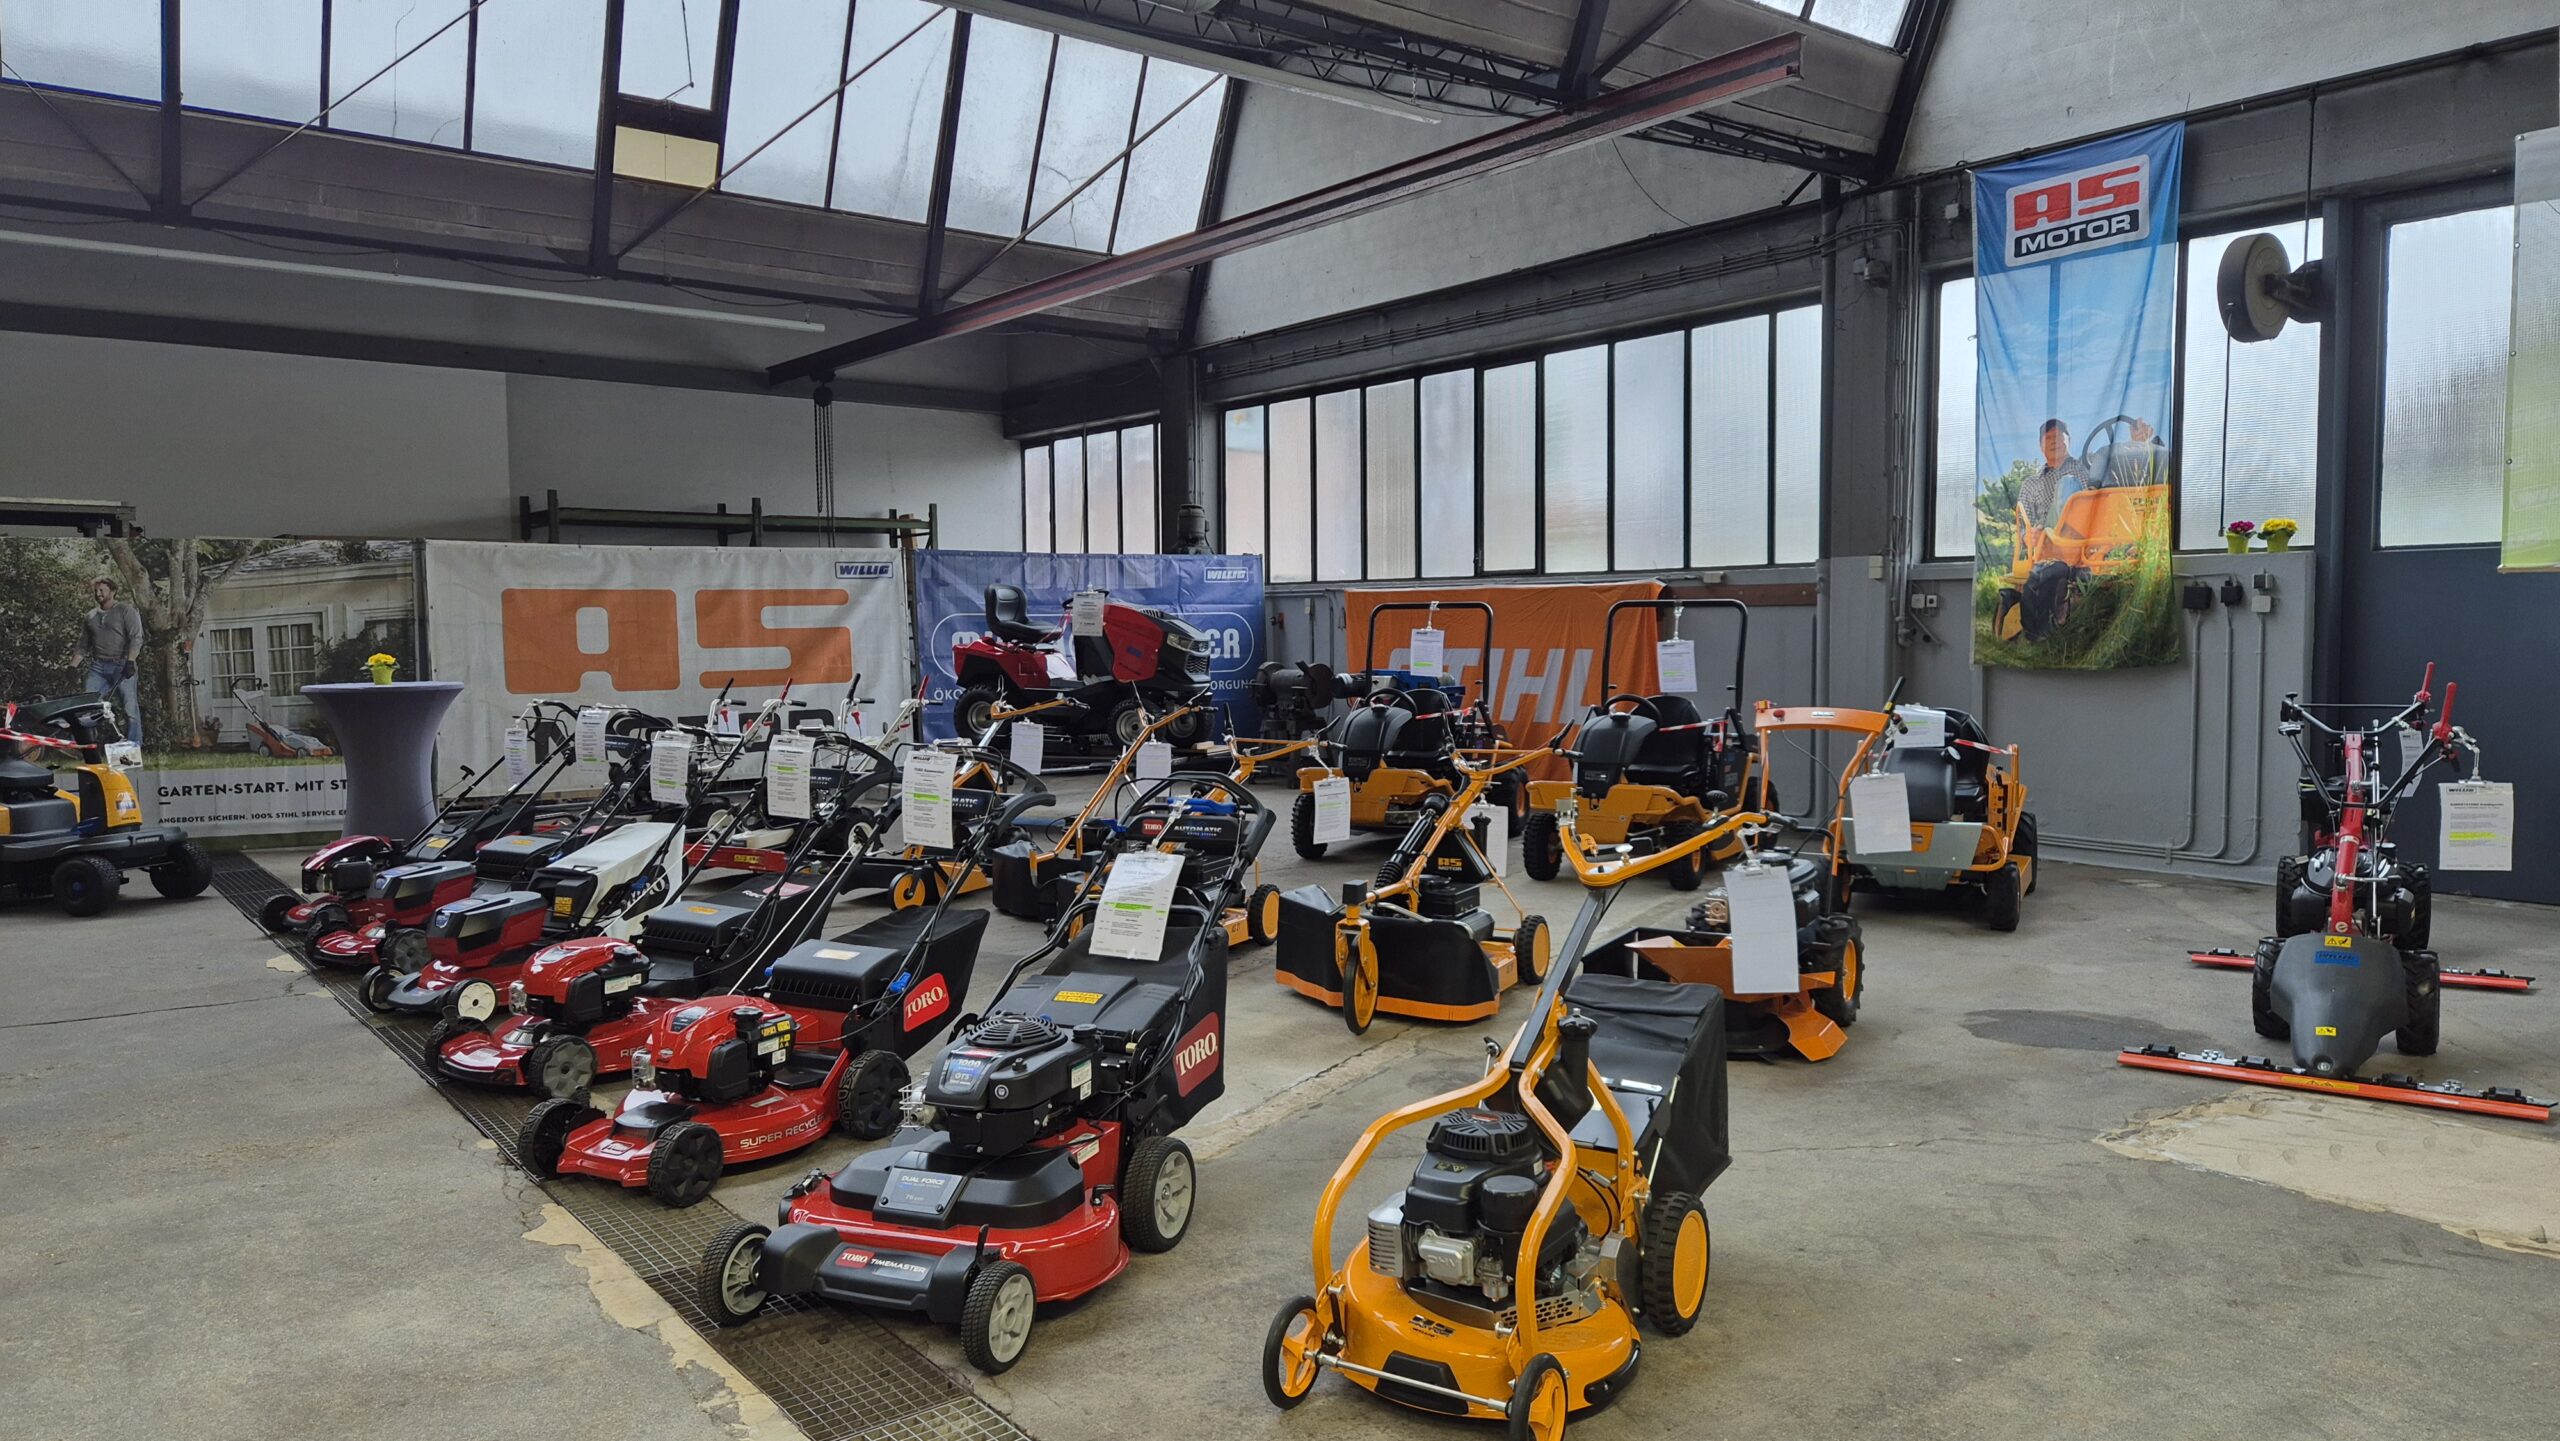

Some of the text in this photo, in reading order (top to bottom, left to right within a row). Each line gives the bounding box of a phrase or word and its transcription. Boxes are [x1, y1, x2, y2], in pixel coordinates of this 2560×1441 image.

[2013, 164, 2141, 232] AS
[2021, 213, 2131, 254] MOTOR
[839, 565, 890, 575] WILLIG
[1207, 570, 1246, 579] WILLIG
[501, 588, 853, 694] AS
[157, 781, 289, 797] GARTEN-START.
[295, 780, 324, 792] MIT
[158, 815, 205, 824] ANGEBOTE
[251, 812, 273, 820] 100%
[276, 811, 299, 819] STIHL
[302, 809, 336, 818] SERVICE
[1173, 825, 1223, 833] AUTOMATIC
[1438, 857, 1462, 867] AS
[905, 986, 944, 1019] TORO
[1175, 1032, 1217, 1076] TORO
[740, 1131, 783, 1149] SUPER
[901, 1175, 920, 1184] DUAL
[921, 1177, 946, 1186] FORCE
[841, 1252, 927, 1274] TORO TIMEMASTER
